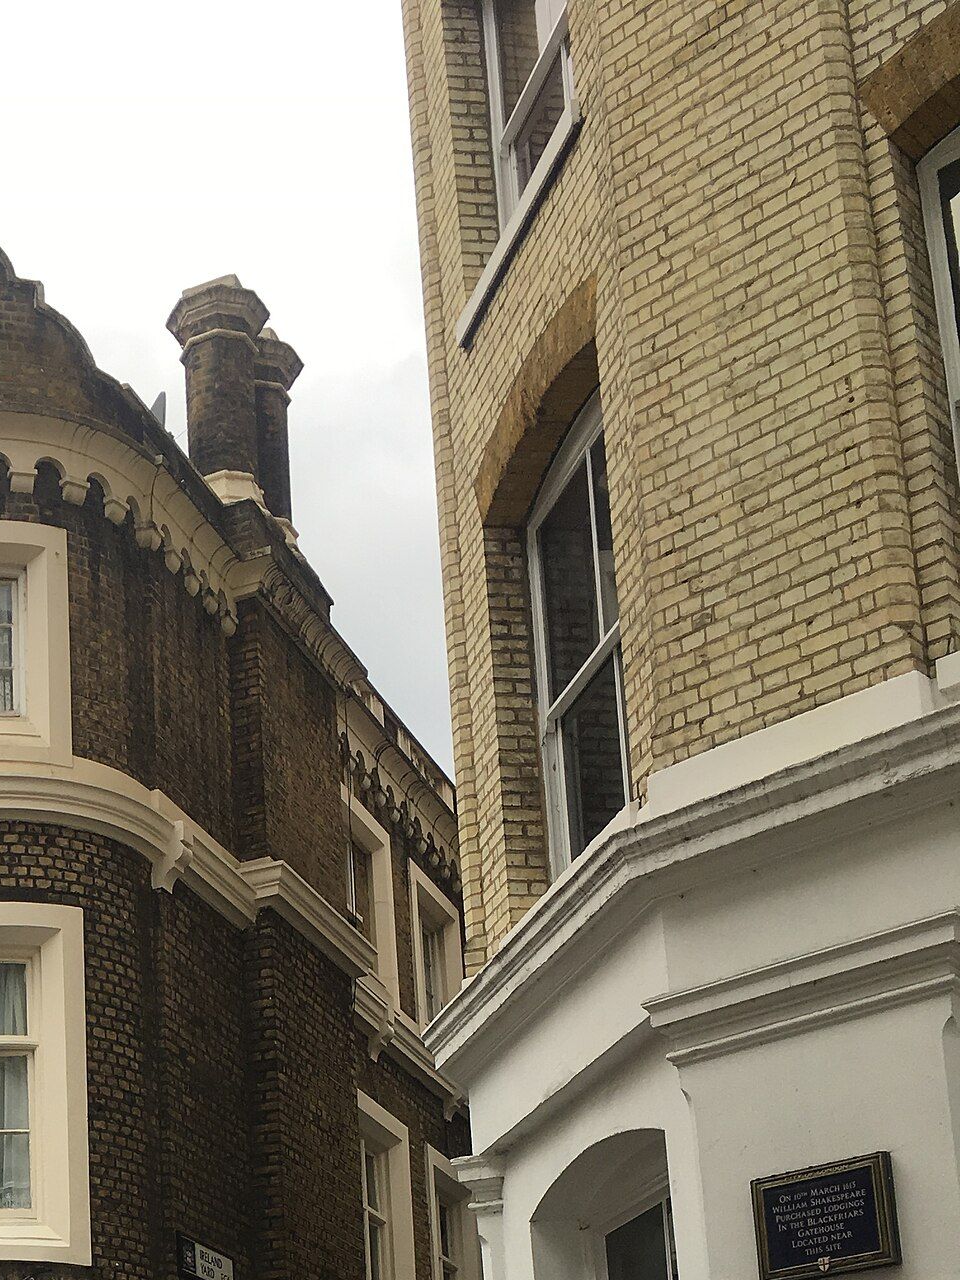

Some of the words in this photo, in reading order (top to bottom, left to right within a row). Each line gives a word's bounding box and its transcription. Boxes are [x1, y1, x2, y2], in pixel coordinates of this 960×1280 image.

[810, 1185, 840, 1197] MARCH
[772, 1202, 807, 1213] WILLIAM
[810, 1188, 866, 1206] SHAKESPEARE
[775, 1208, 821, 1223] PURCHASED
[824, 1199, 865, 1213] LODGINGS
[778, 1224, 787, 1232] IN
[790, 1221, 805, 1229] THE
[807, 1208, 864, 1226] BLACKFRIARS
[797, 1222, 844, 1237] GATEHOUSE
[792, 1235, 828, 1248] LOCATED
[831, 1231, 853, 1241] NEAR
[805, 1245, 823, 1256] THIS
[826, 1243, 842, 1252] SITE
[201, 1263, 215, 1278] YARD
